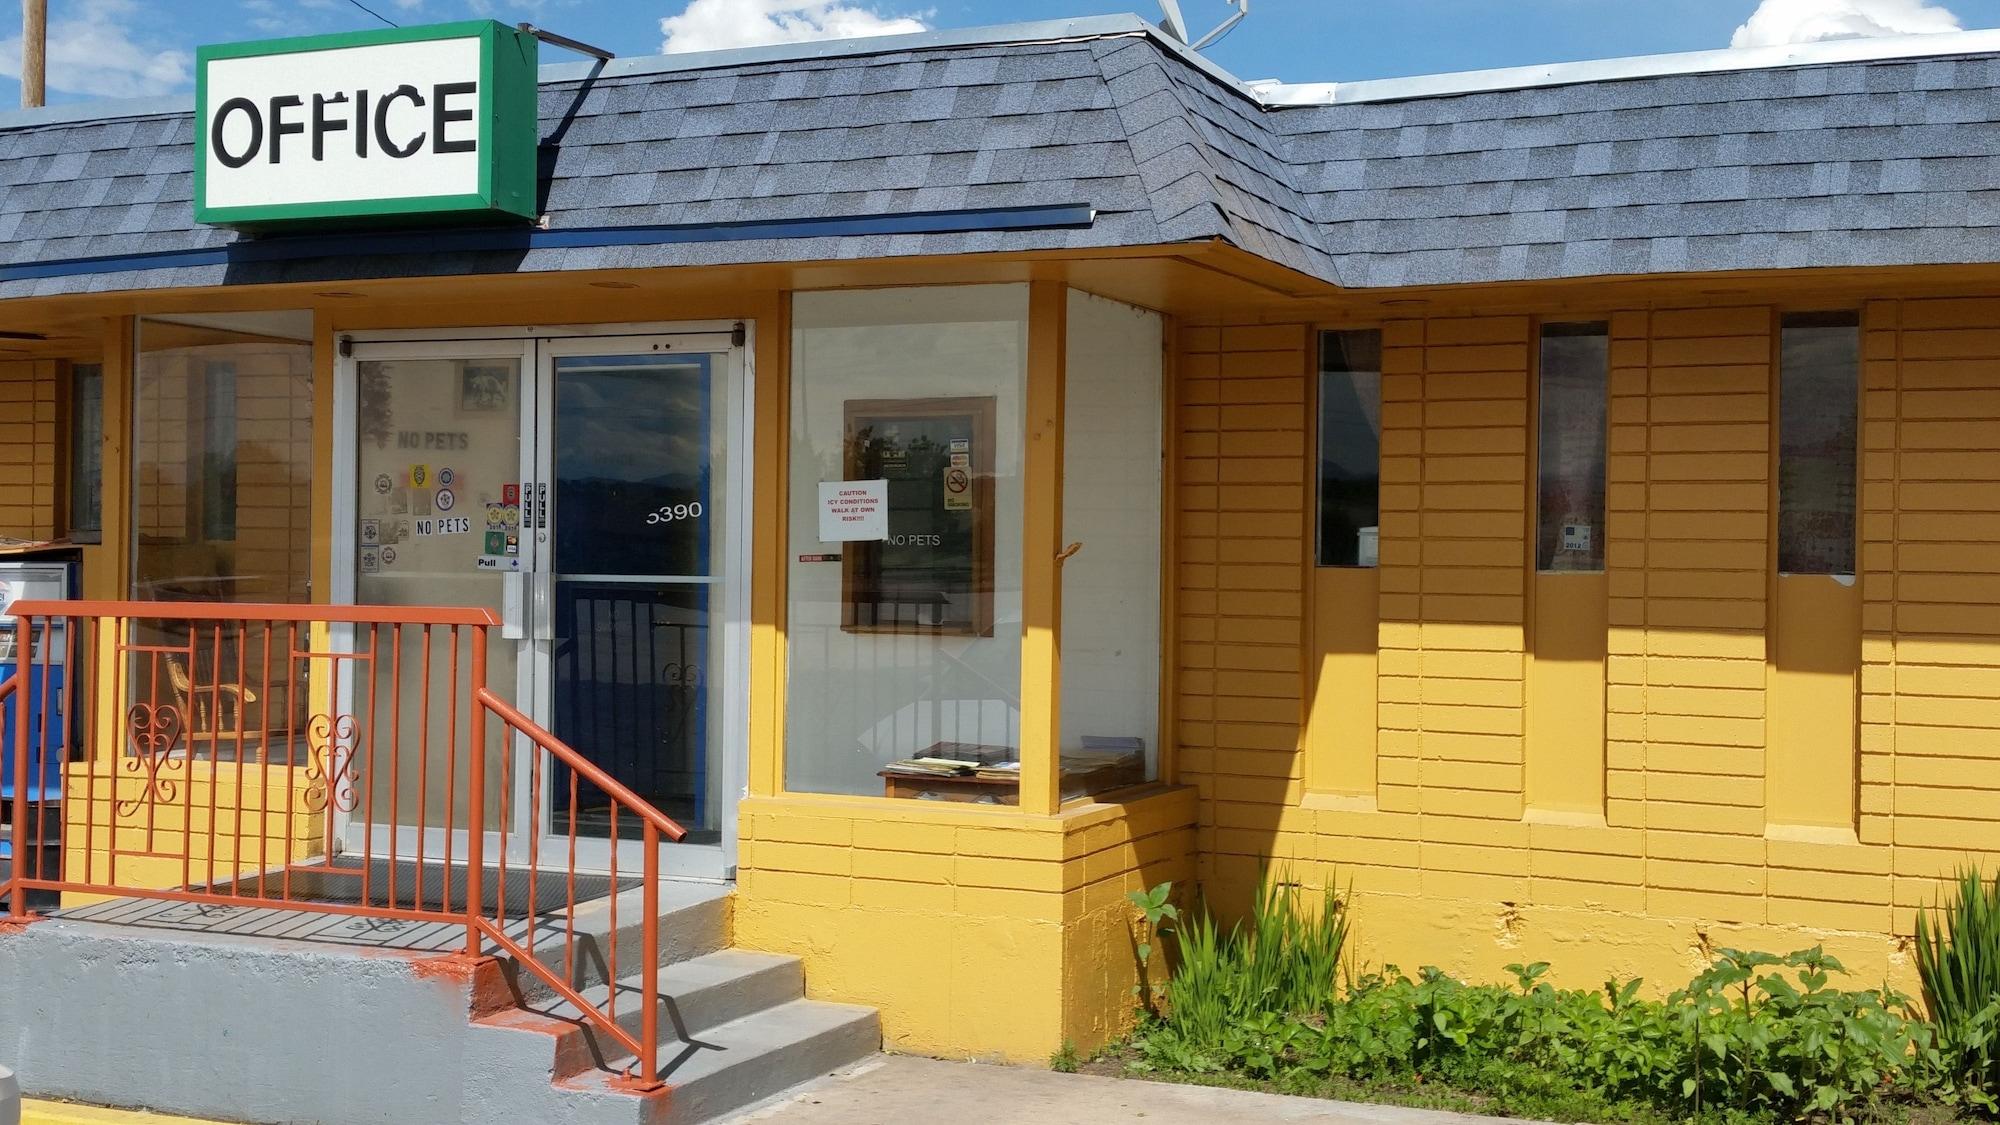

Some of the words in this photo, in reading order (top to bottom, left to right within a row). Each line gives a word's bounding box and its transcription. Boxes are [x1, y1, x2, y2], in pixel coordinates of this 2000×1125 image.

[211, 81, 477, 169] OFFICE
[397, 431, 419, 449] NO
[425, 431, 469, 450] PETS
[416, 520, 432, 535] NO
[438, 518, 469, 534] PETS
[887, 535, 906, 546] NO
[908, 534, 941, 546] PETS
[478, 558, 496, 567] Pull
